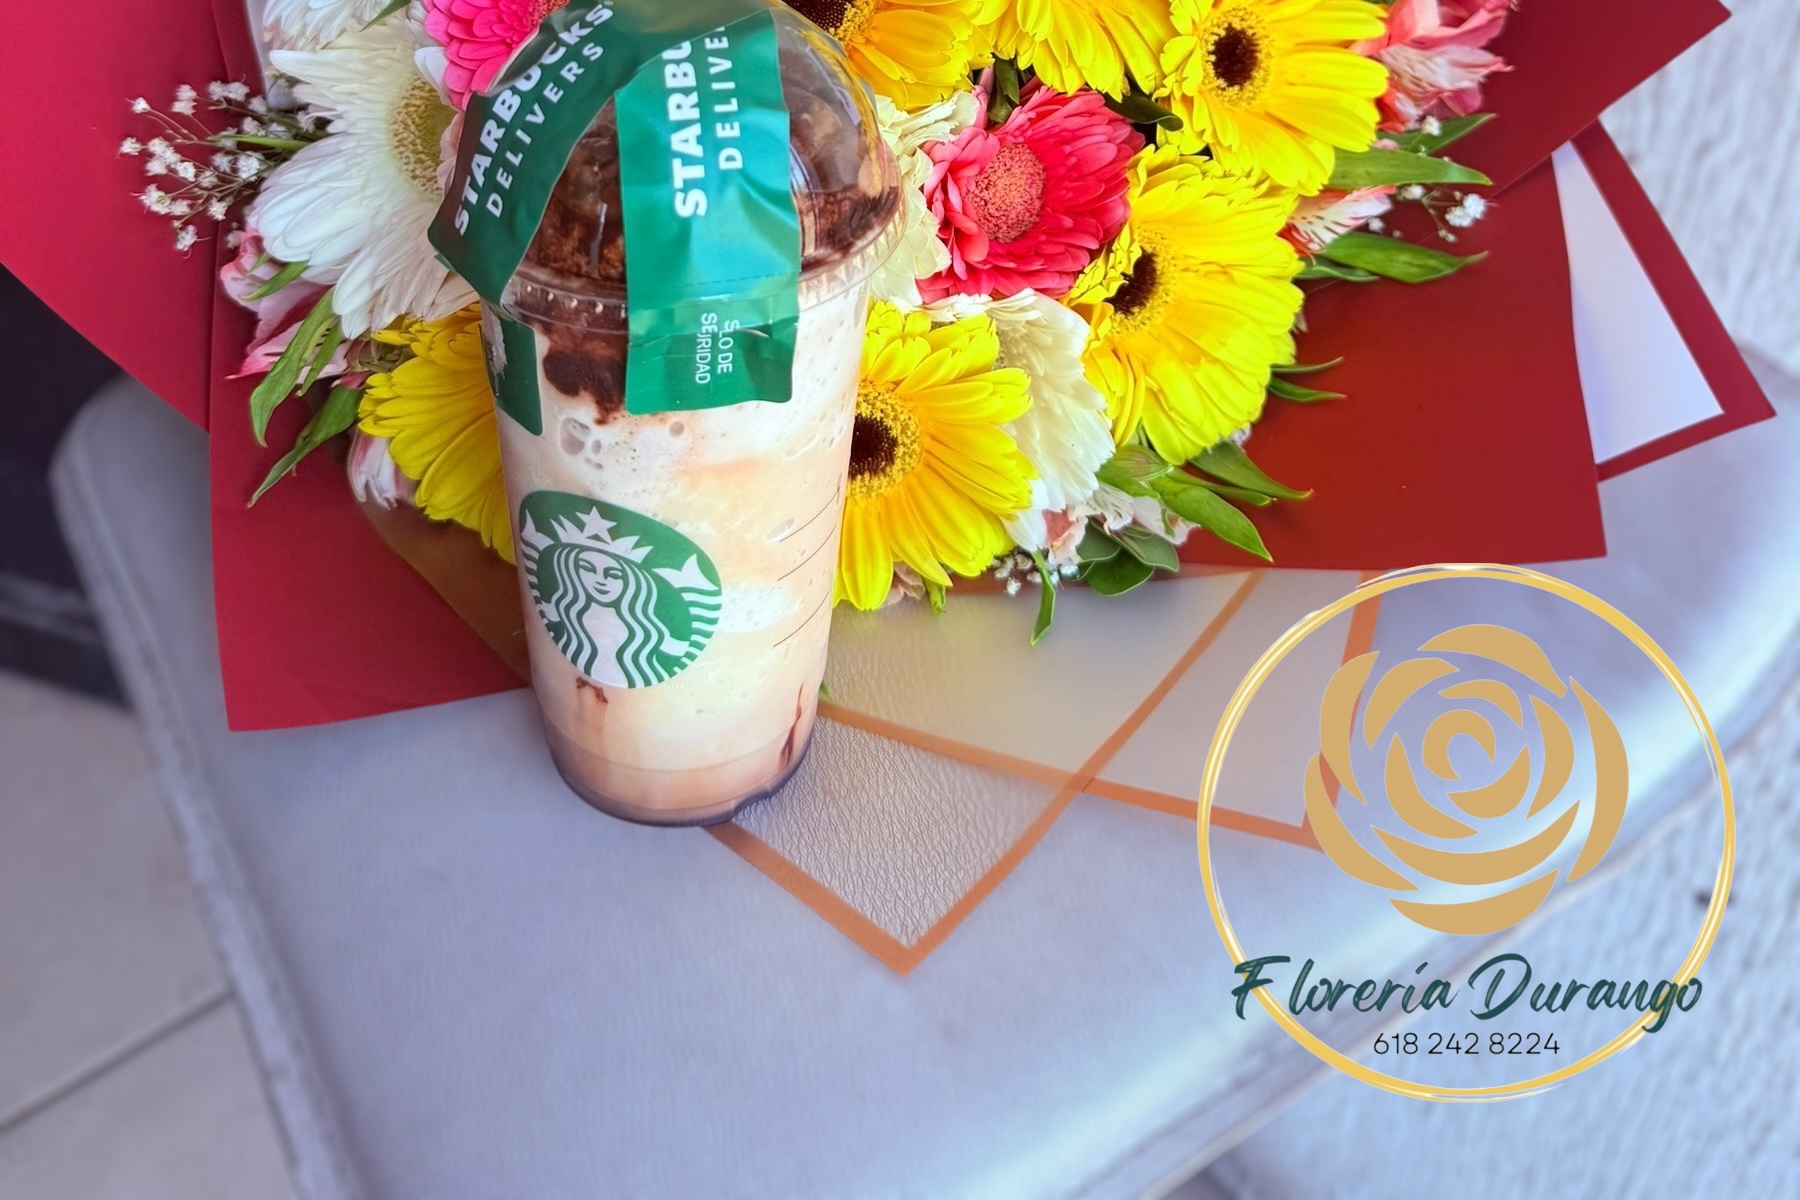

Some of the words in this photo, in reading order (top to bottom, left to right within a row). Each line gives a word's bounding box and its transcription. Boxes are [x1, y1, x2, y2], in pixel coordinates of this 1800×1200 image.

[455, 3, 614, 236] STARBUCKS
[486, 42, 604, 218] DELIVERS
[662, 40, 708, 218] STARBU
[703, 27, 743, 170] DELIVE
[717, 352, 733, 374] DE
